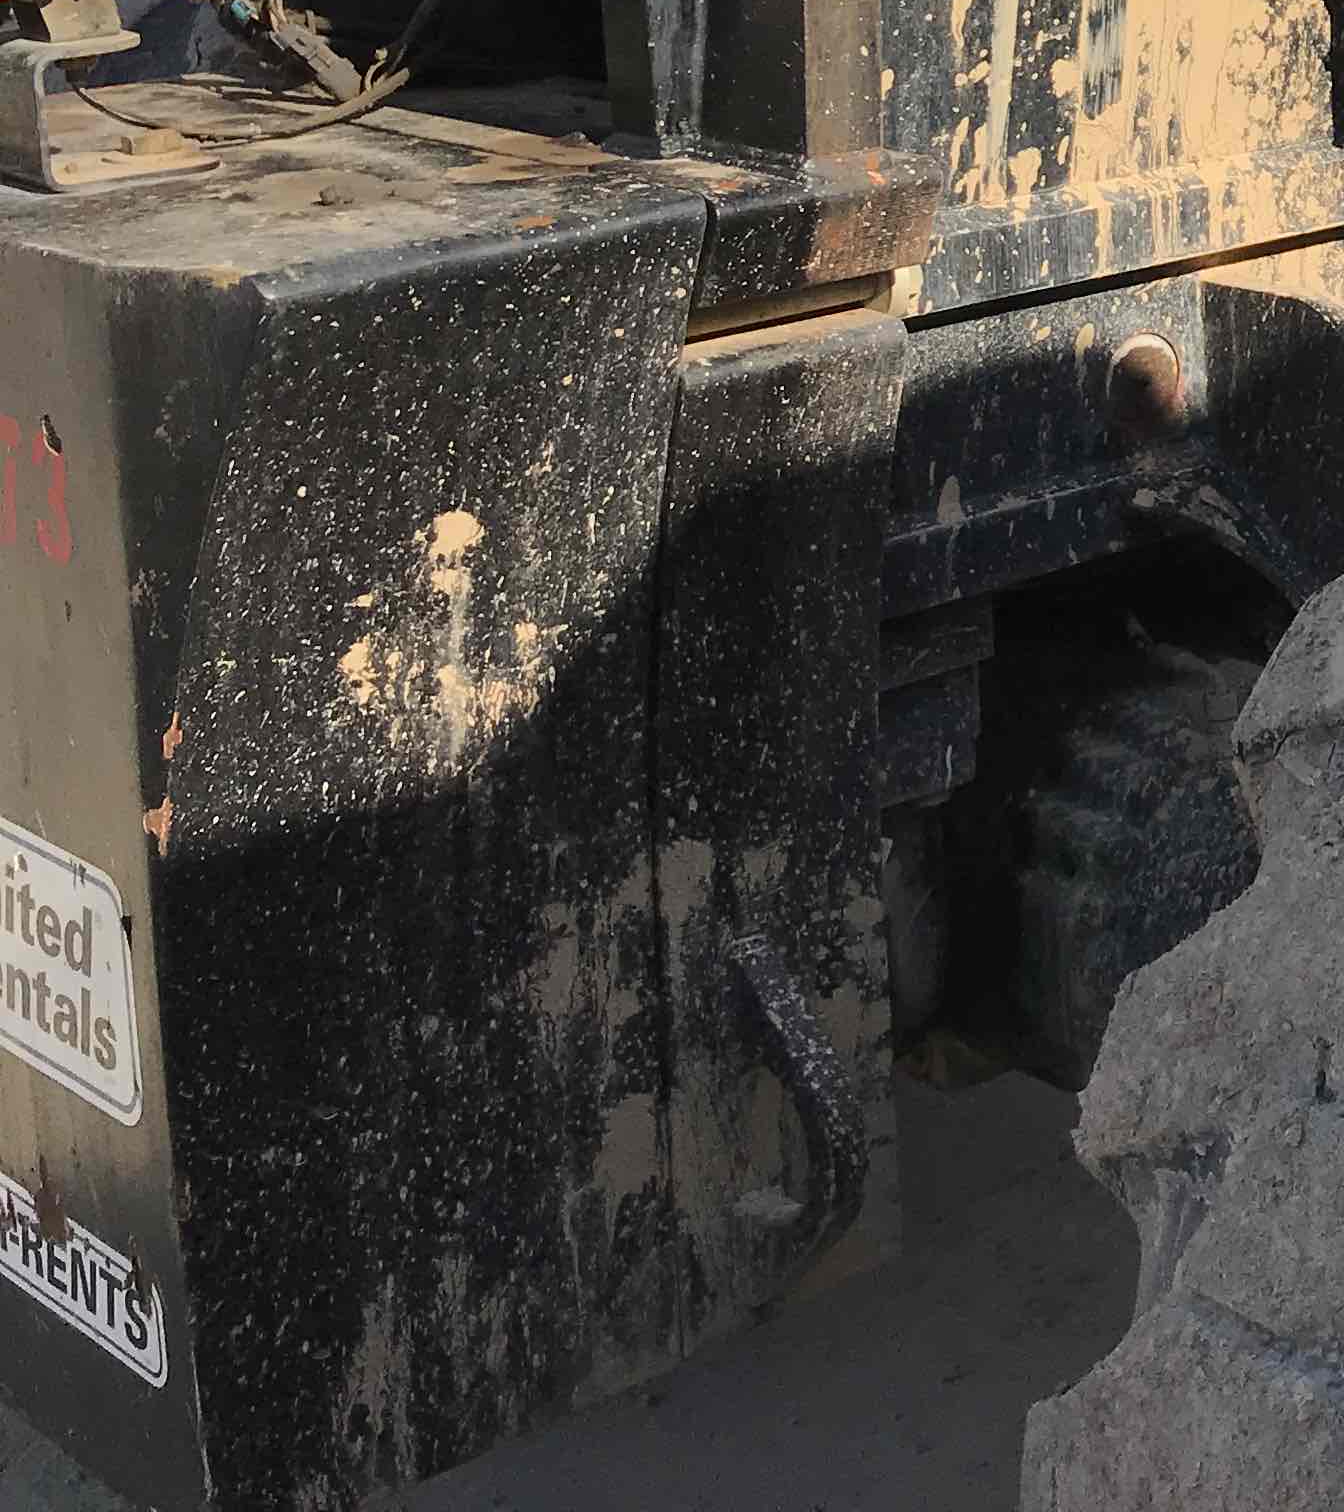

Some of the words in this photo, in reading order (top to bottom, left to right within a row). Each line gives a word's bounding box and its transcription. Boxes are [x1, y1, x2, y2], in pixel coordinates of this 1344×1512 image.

[0, 864, 93, 978] ited
[0, 960, 117, 1071] ntals
[0, 1210, 148, 1350] -RENTS
